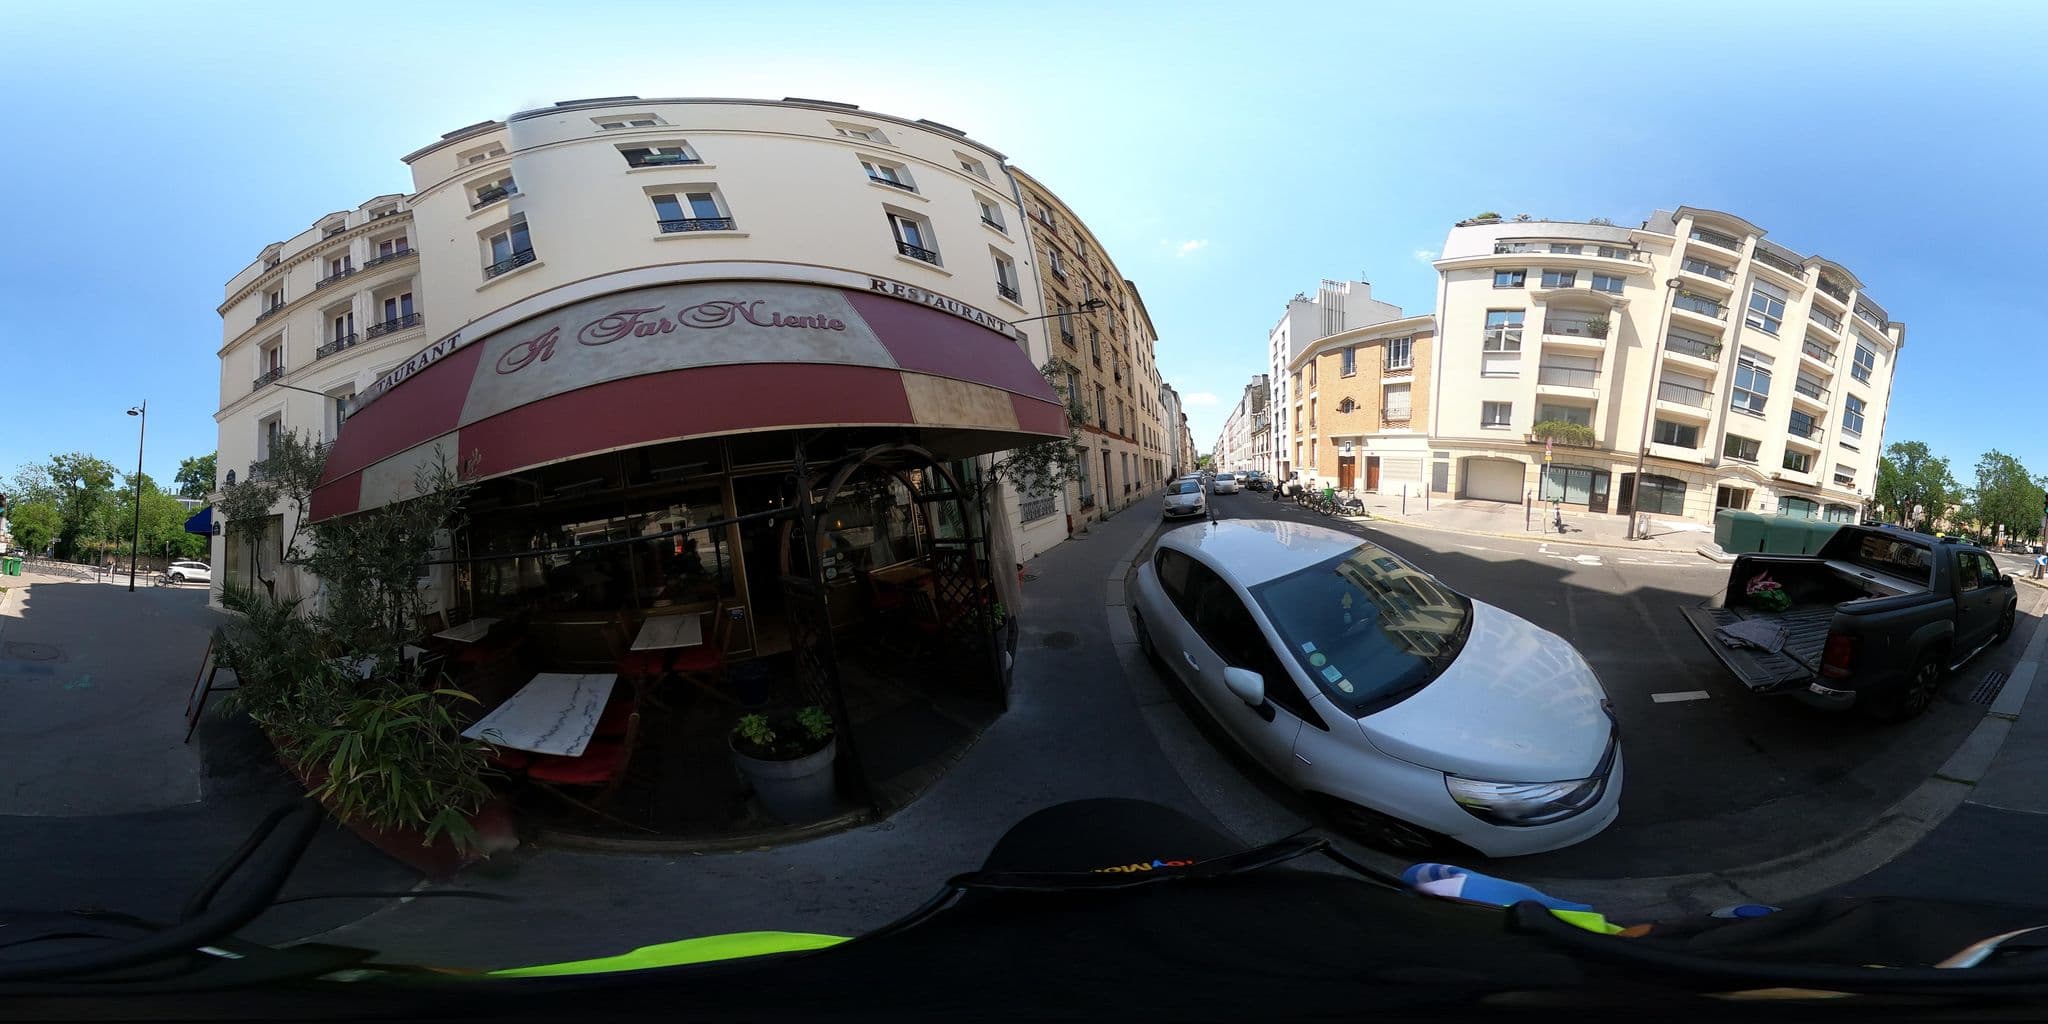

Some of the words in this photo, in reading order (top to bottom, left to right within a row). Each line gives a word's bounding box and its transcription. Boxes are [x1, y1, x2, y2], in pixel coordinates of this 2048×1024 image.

[870, 278, 1006, 332] RESTAURANT
[496, 325, 560, 375] Il
[577, 305, 677, 347] Far
[677, 300, 847, 332] Niente
